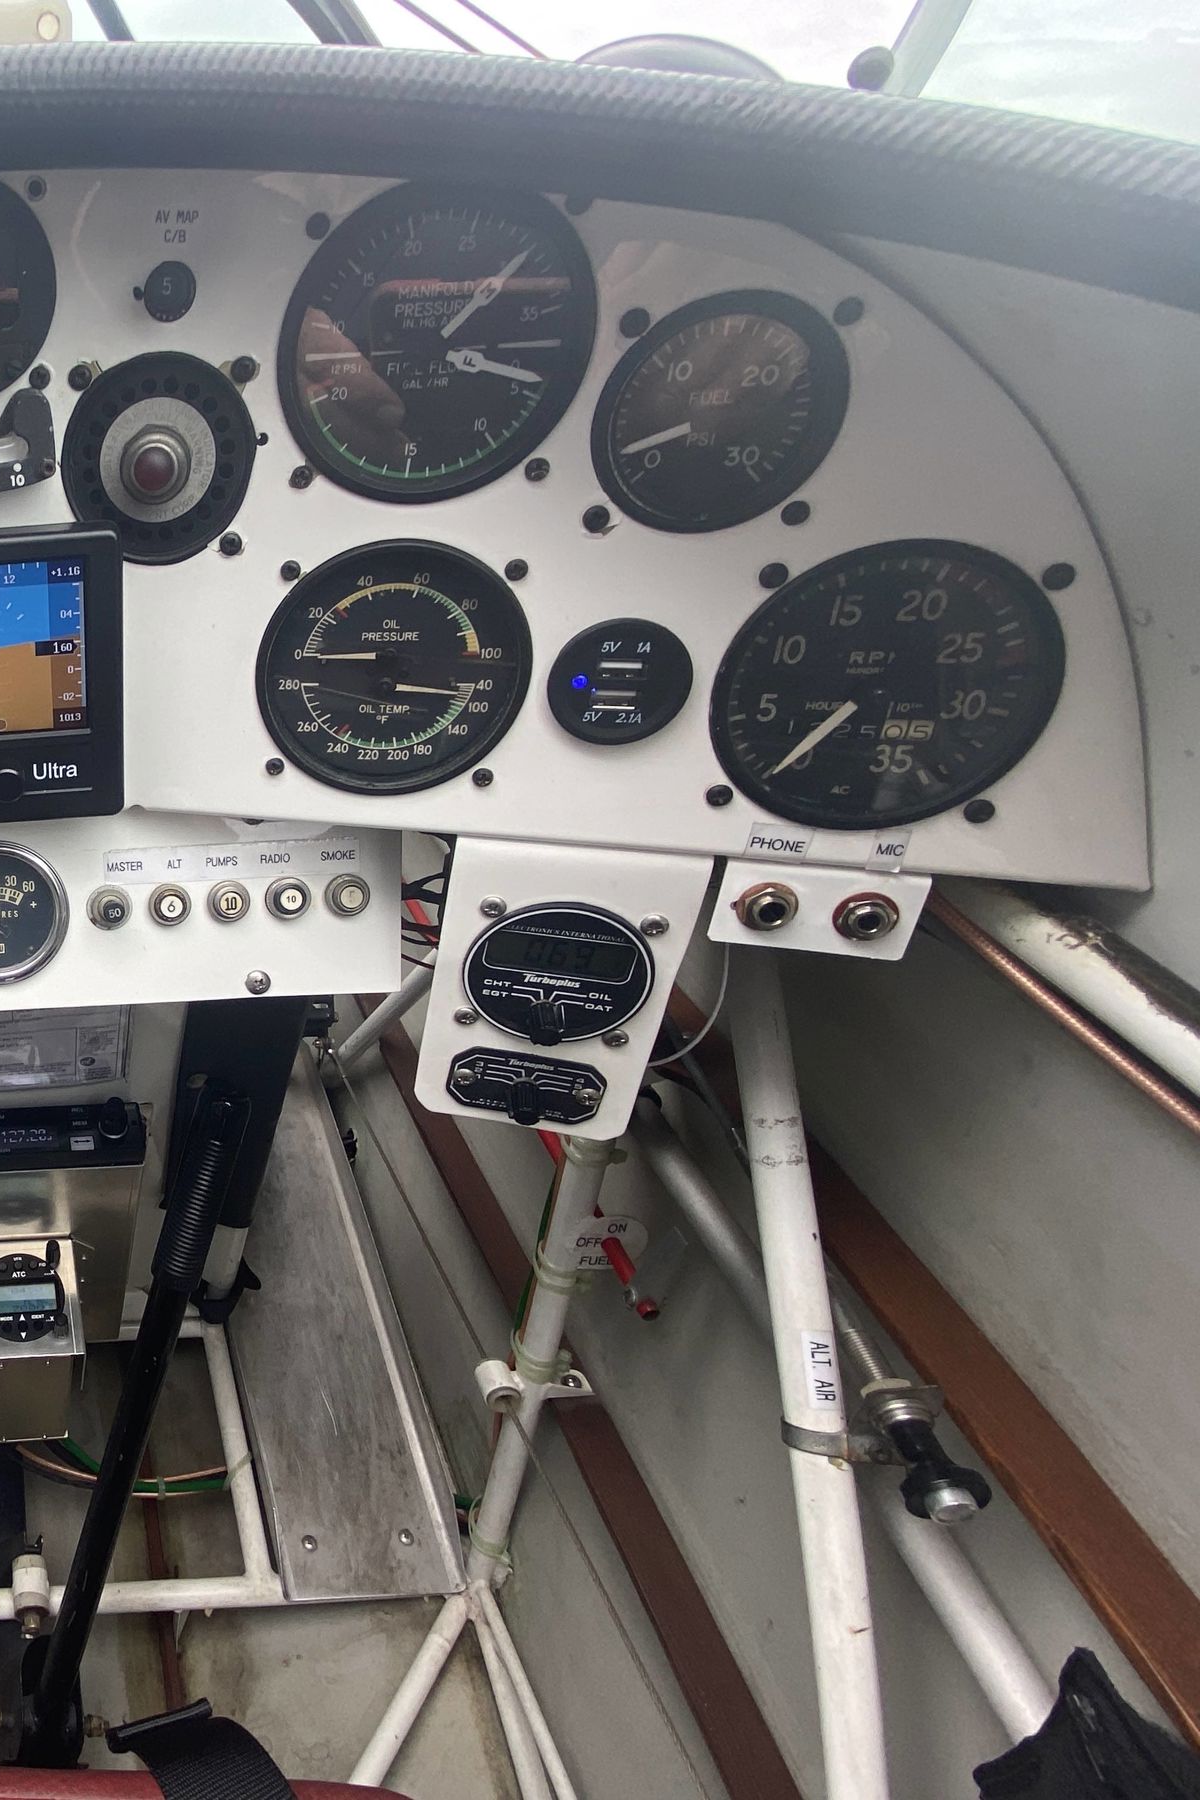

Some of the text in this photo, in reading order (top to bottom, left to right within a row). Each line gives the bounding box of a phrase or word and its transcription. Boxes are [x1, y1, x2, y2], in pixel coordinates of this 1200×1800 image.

[155, 210, 199, 224] AV MAP
[164, 229, 186, 243] C/B
[459, 236, 476, 251] 25
[162, 277, 172, 295] 5
[363, 273, 375, 286] 15
[399, 282, 474, 299] MANIFOLD
[520, 309, 538, 321] 35
[667, 361, 780, 387] 10 20
[331, 388, 347, 400] 20
[689, 390, 731, 405] FUEL
[474, 418, 487, 431] 10
[686, 433, 715, 447] PSI
[405, 443, 417, 455] 15
[644, 446, 759, 469] 0 30
[10, 474, 25, 486] 10
[4, 575, 15, 584] 12
[357, 573, 429, 586] 40 60
[461, 599, 478, 610] 80
[830, 589, 947, 626] 15 20
[60, 610, 72, 618] 04
[308, 607, 322, 619] 20
[382, 620, 400, 628] OIL
[361, 631, 419, 641] PRESSURE
[294, 648, 502, 659] 0 100
[601, 642, 651, 653] 5V 1A
[773, 632, 986, 664] 10 25
[278, 680, 493, 690] 280 40
[359, 705, 375, 713] OIL
[468, 702, 488, 712] 100
[756, 690, 987, 722] 5 30
[59, 712, 81, 722] 1013
[582, 712, 642, 723] 5V 2.1A
[297, 722, 468, 735] 260 140
[327, 743, 432, 760] 240 220 200 180
[869, 744, 914, 773] 35
[32, 762, 78, 780] Ultra
[750, 836, 805, 853] PHONE
[877, 843, 905, 856] MIC
[107, 850, 355, 872] MASTER ALT PUMPS RADIO SMOKE
[5, 876, 16, 886] 30
[23, 881, 35, 892] 60
[225, 897, 237, 910] 10
[286, 895, 296, 903] 10
[109, 908, 121, 917] 50
[167, 901, 175, 912] 6
[561, 930, 625, 942] INTERNATIONAL
[523, 973, 580, 988] Turboplus
[484, 979, 612, 1001] CHT OIL
[482, 989, 613, 1012] EGT OAT
[508, 1058, 554, 1070] Turboplus
[608, 1224, 627, 1233] ON
[576, 1238, 602, 1247] OFF
[810, 1341, 836, 1401] ALT. AIR
